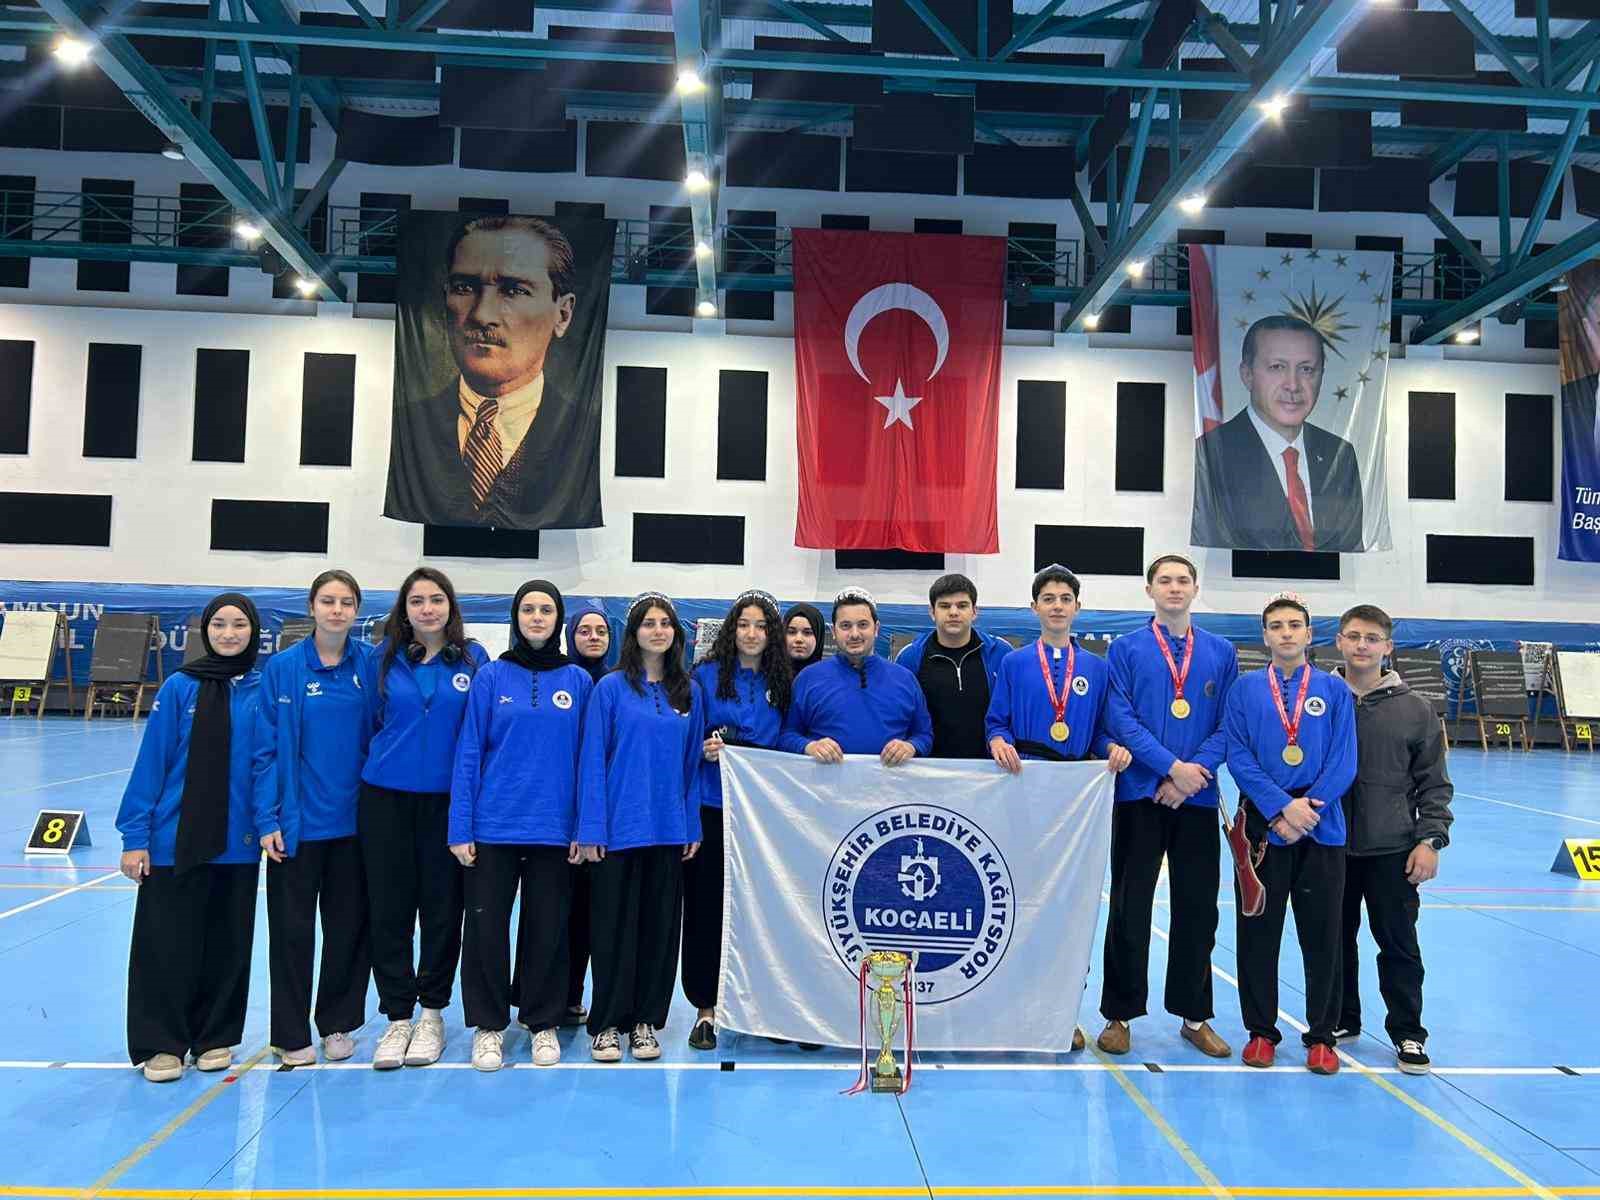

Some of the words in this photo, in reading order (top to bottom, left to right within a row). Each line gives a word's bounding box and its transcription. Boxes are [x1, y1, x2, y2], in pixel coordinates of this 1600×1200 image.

[1496, 723, 1511, 735] 20
[43, 818, 65, 843] 8
[1573, 846, 1600, 872] 15
[830, 830, 875, 963] ÜYÜKŞEHİR
[875, 813, 982, 853] BELEDİYE
[959, 852, 1011, 980] KAĞITSPOR
